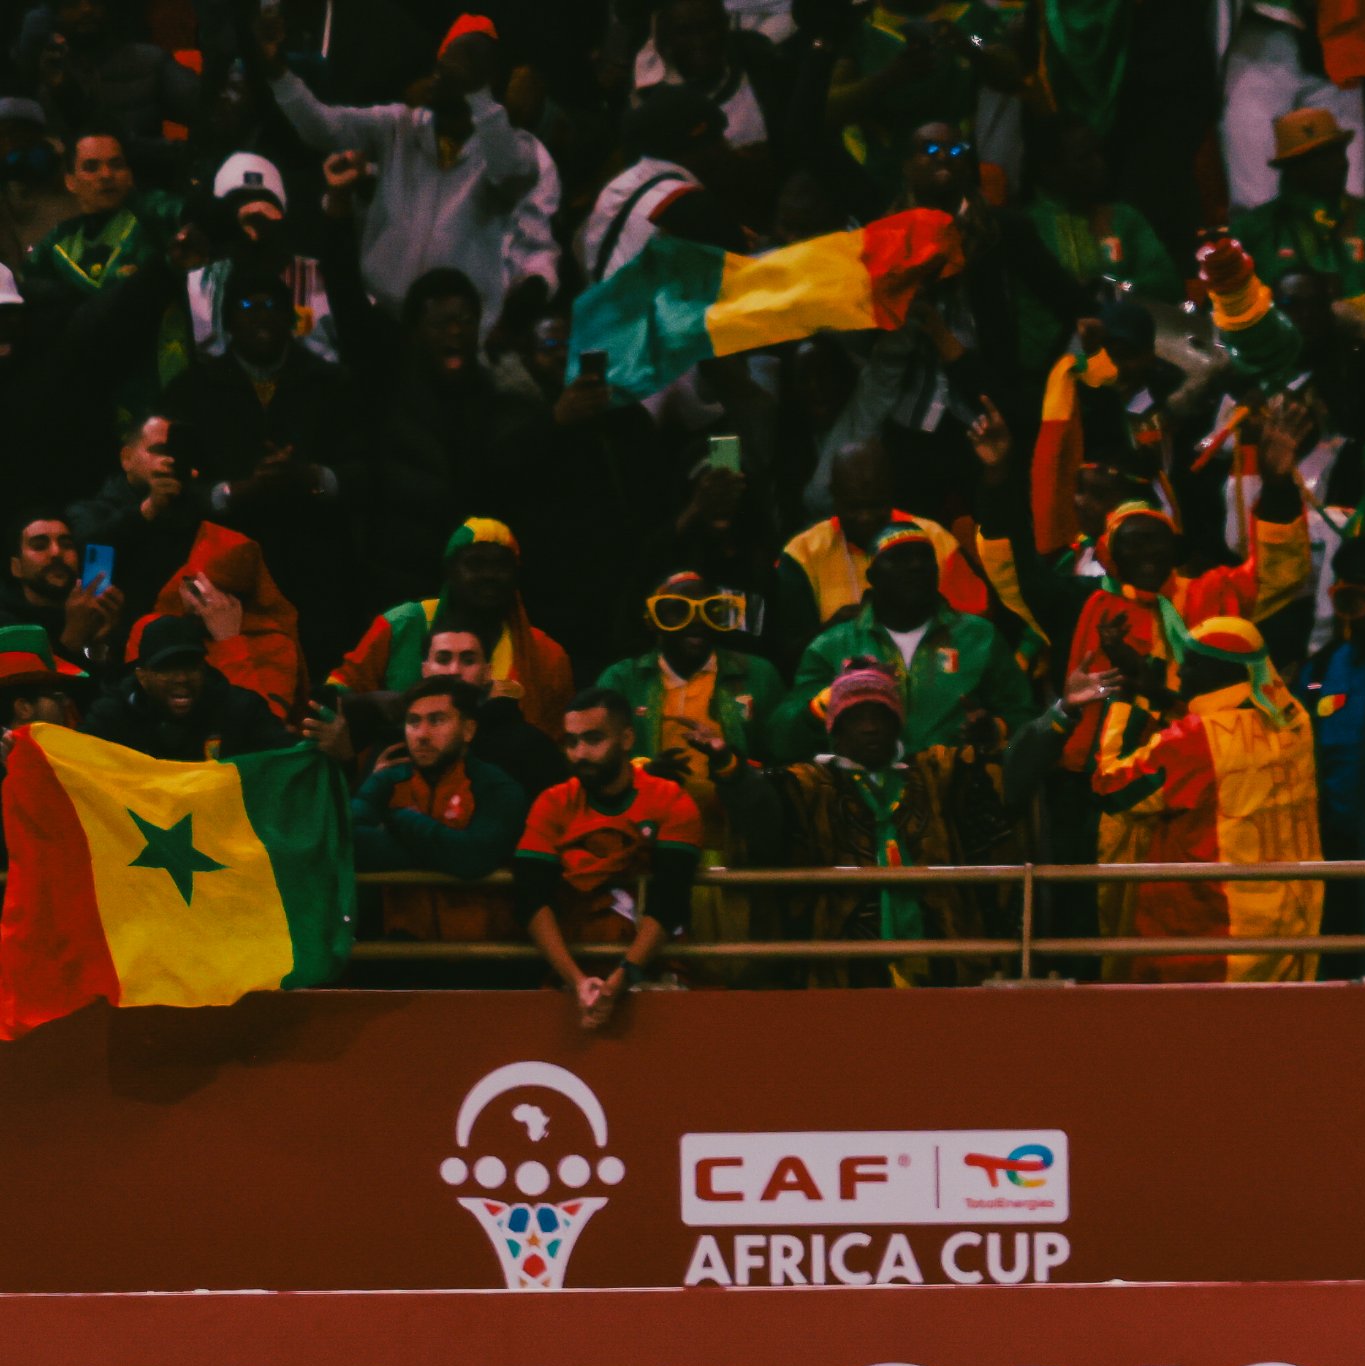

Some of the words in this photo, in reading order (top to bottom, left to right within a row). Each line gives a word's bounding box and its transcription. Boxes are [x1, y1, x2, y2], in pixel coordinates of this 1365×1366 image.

[694, 1155, 889, 1203] CAF
[685, 1231, 924, 1287] AFRICA
[940, 1230, 1072, 1285] CUP
